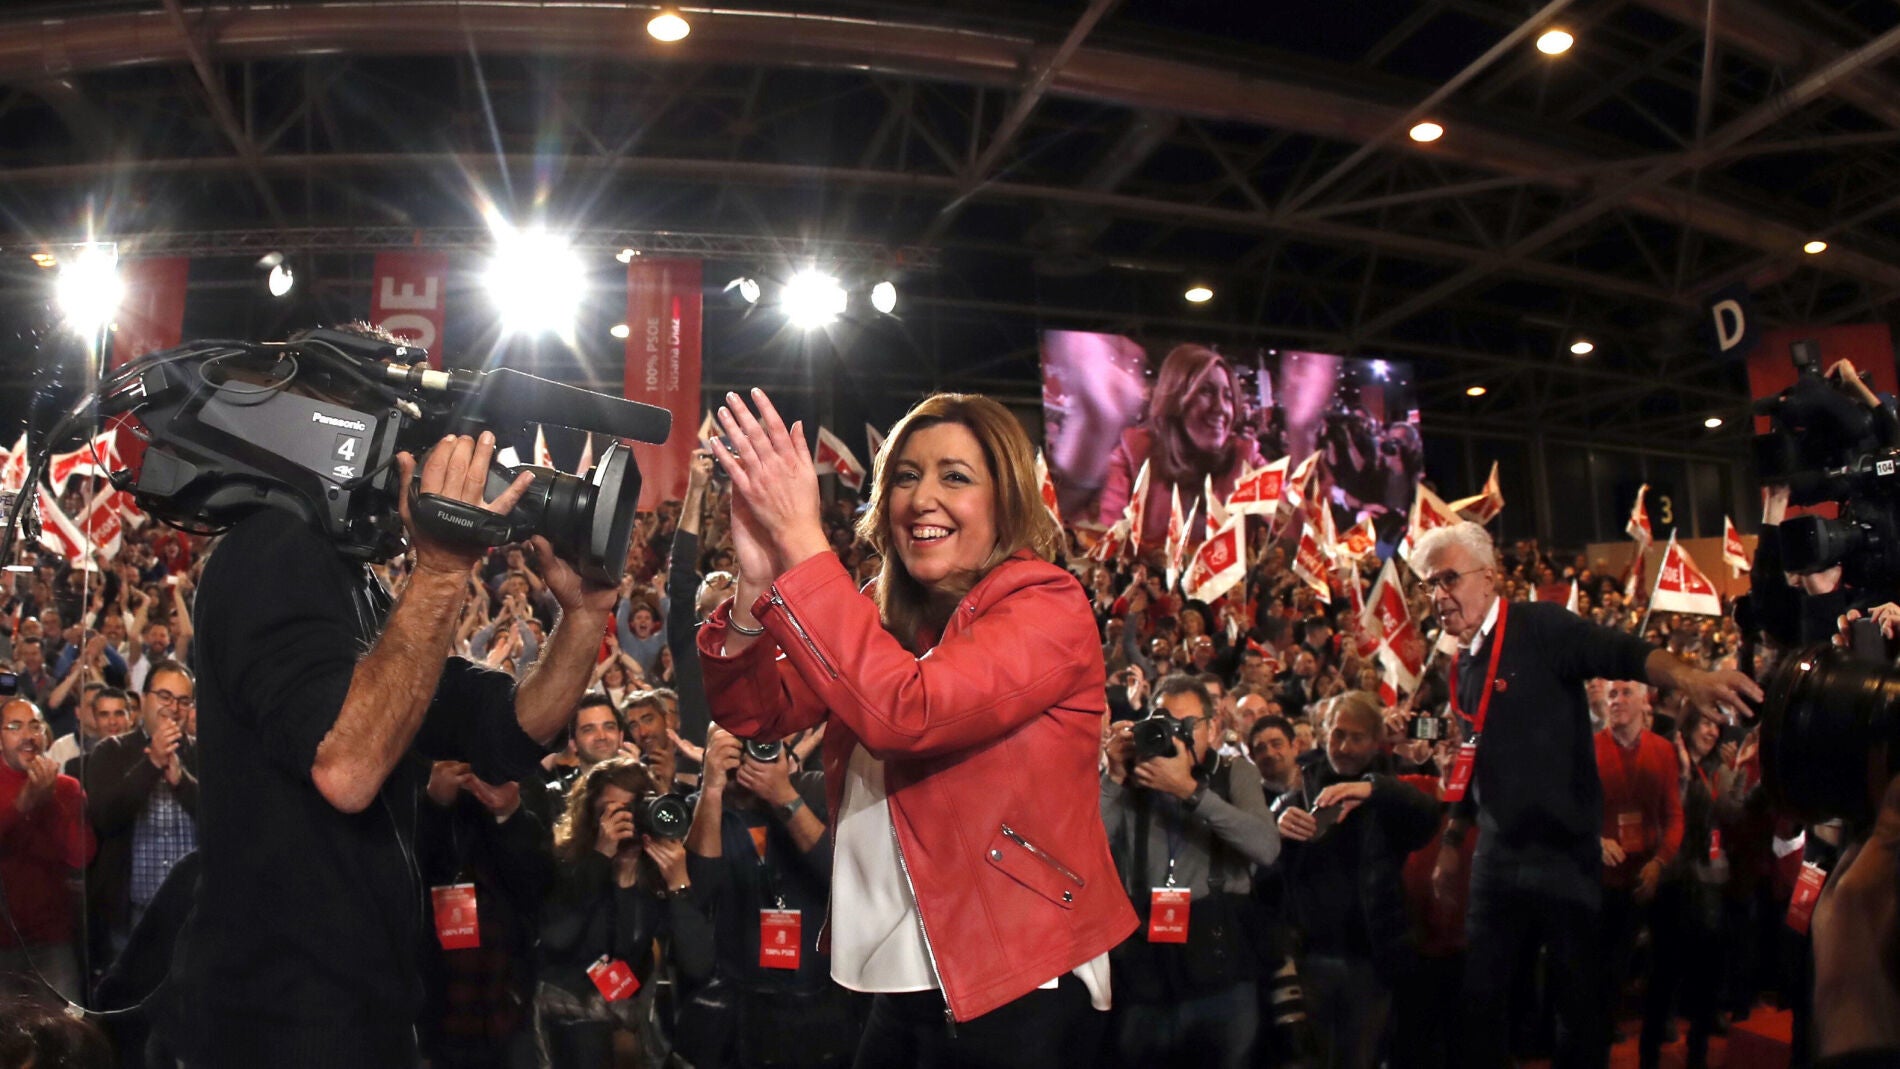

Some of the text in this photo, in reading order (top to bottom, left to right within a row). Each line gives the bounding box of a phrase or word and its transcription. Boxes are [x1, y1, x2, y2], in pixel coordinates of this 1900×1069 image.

[1712, 300, 1745, 351] D
[646, 317, 659, 393] 100% PSOE
[666, 348, 680, 392] Susana
[312, 411, 367, 432] Panasonic
[337, 437, 356, 461] 4
[1877, 462, 1893, 474] 104
[437, 510, 474, 528] FUJINON
[1660, 495, 1673, 524] 3
[1661, 565, 1681, 584] SOE
